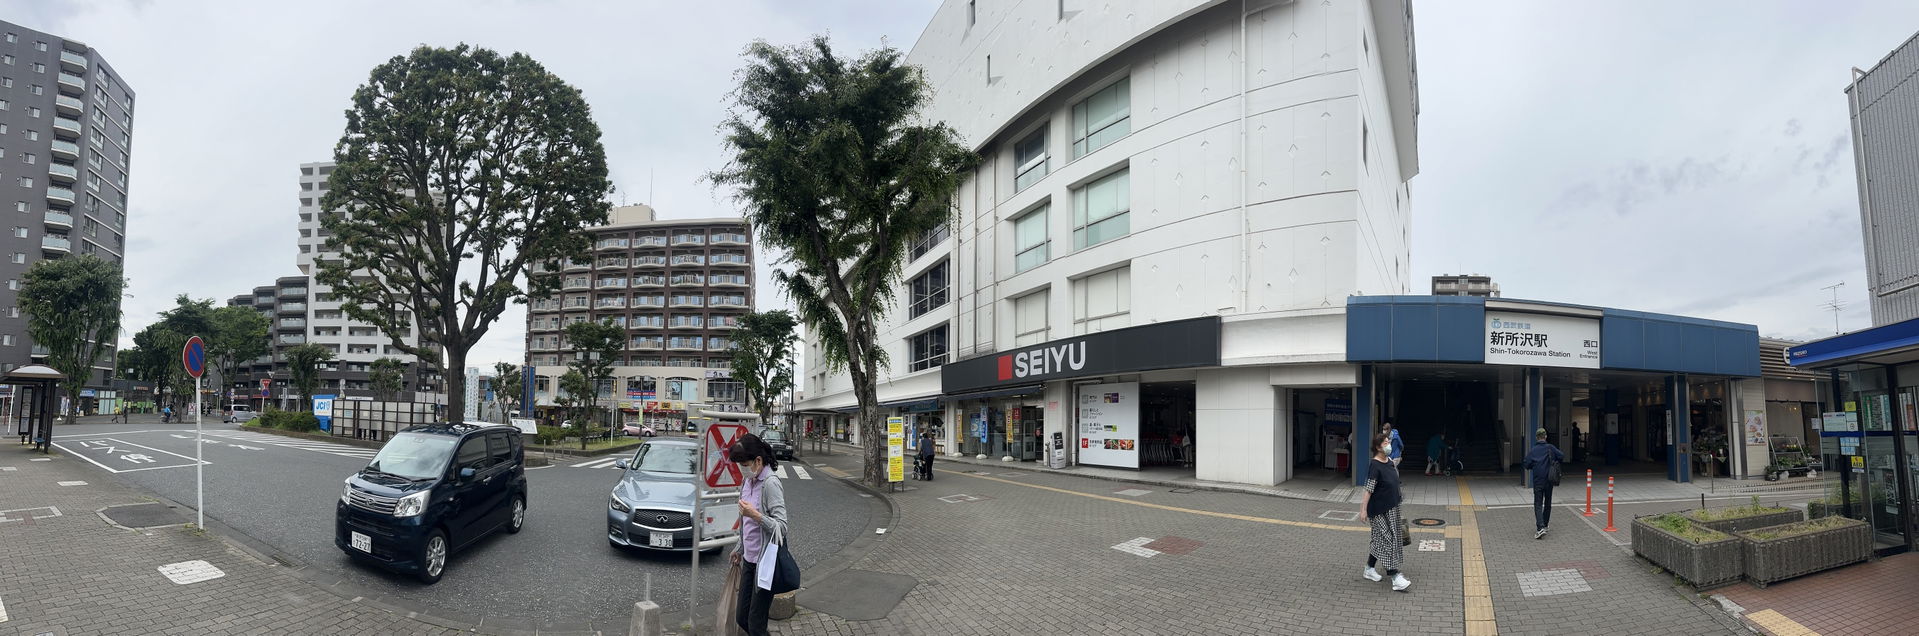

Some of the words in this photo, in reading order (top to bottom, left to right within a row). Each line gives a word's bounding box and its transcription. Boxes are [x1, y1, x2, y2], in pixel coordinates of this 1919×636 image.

[1490, 331, 1548, 348] 新所沢駅
[1584, 340, 1598, 348] 西口
[1490, 347, 1546, 356] Shin-Tokorozawa
[1014, 341, 1086, 378] SEIYU
